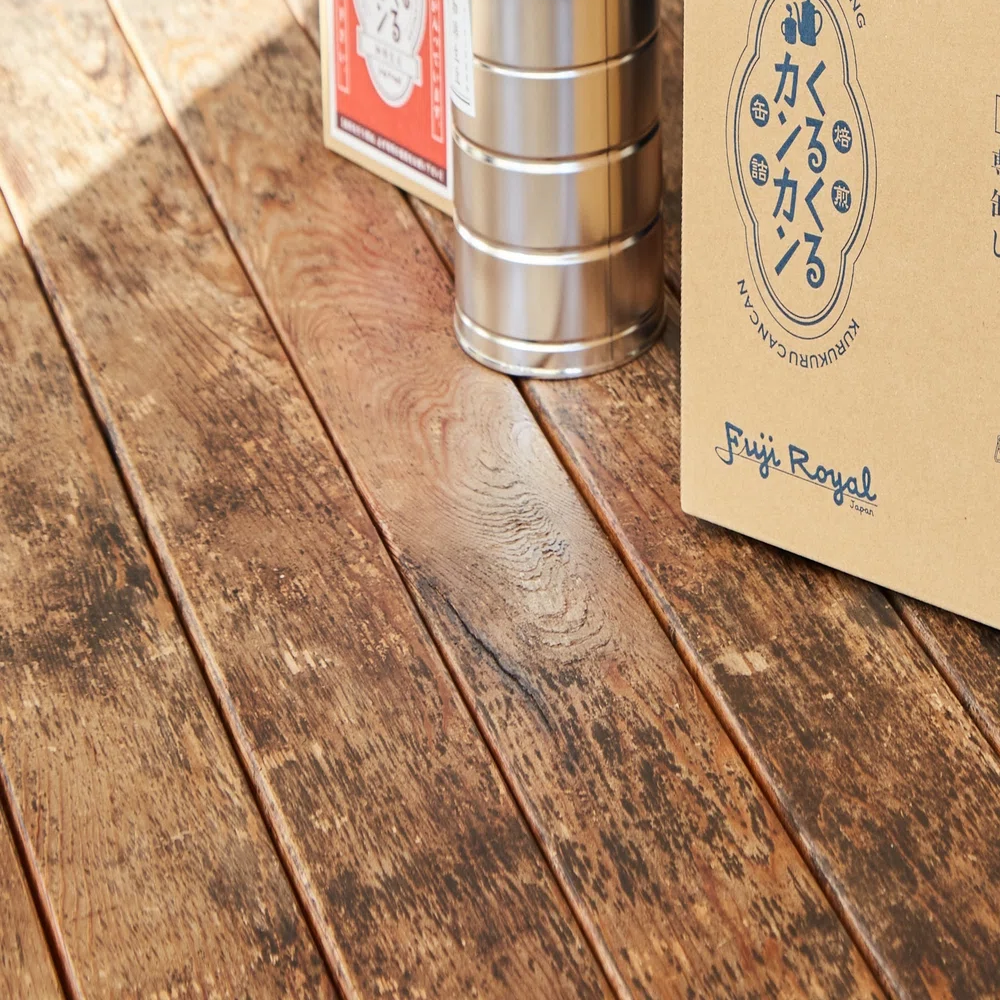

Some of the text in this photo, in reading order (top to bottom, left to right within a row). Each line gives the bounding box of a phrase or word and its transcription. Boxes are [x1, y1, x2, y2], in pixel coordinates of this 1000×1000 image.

[772, 51, 802, 276] カンカン
[804, 60, 827, 289] くるくる
[737, 279, 860, 369] KURUKURUCANCAN
[715, 421, 877, 506] Fuji Royal
[850, 500, 875, 517] Japan
